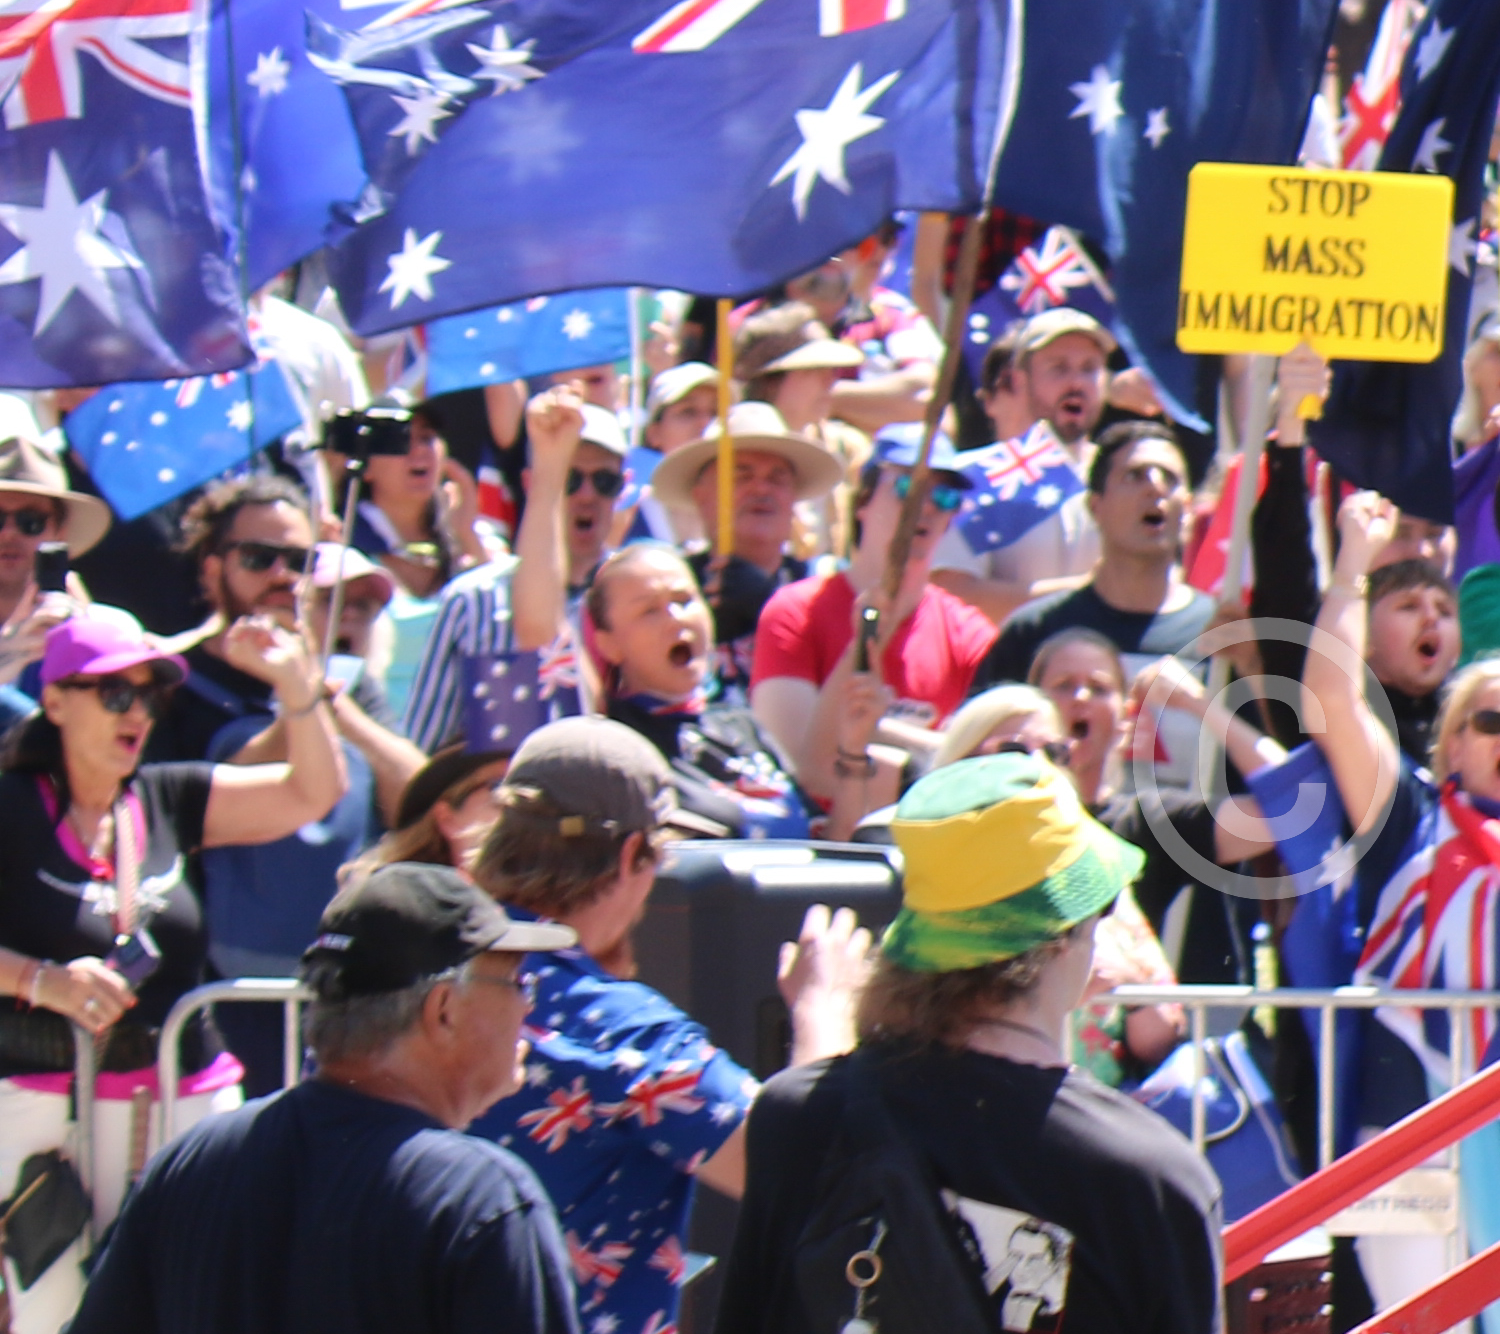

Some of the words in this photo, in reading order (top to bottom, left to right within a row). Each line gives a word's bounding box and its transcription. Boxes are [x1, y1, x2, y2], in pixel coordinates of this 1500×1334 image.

[1266, 175, 1372, 218] STOP
[1261, 235, 1367, 278] MASS
[1178, 289, 1439, 345] IMMIGRATION
